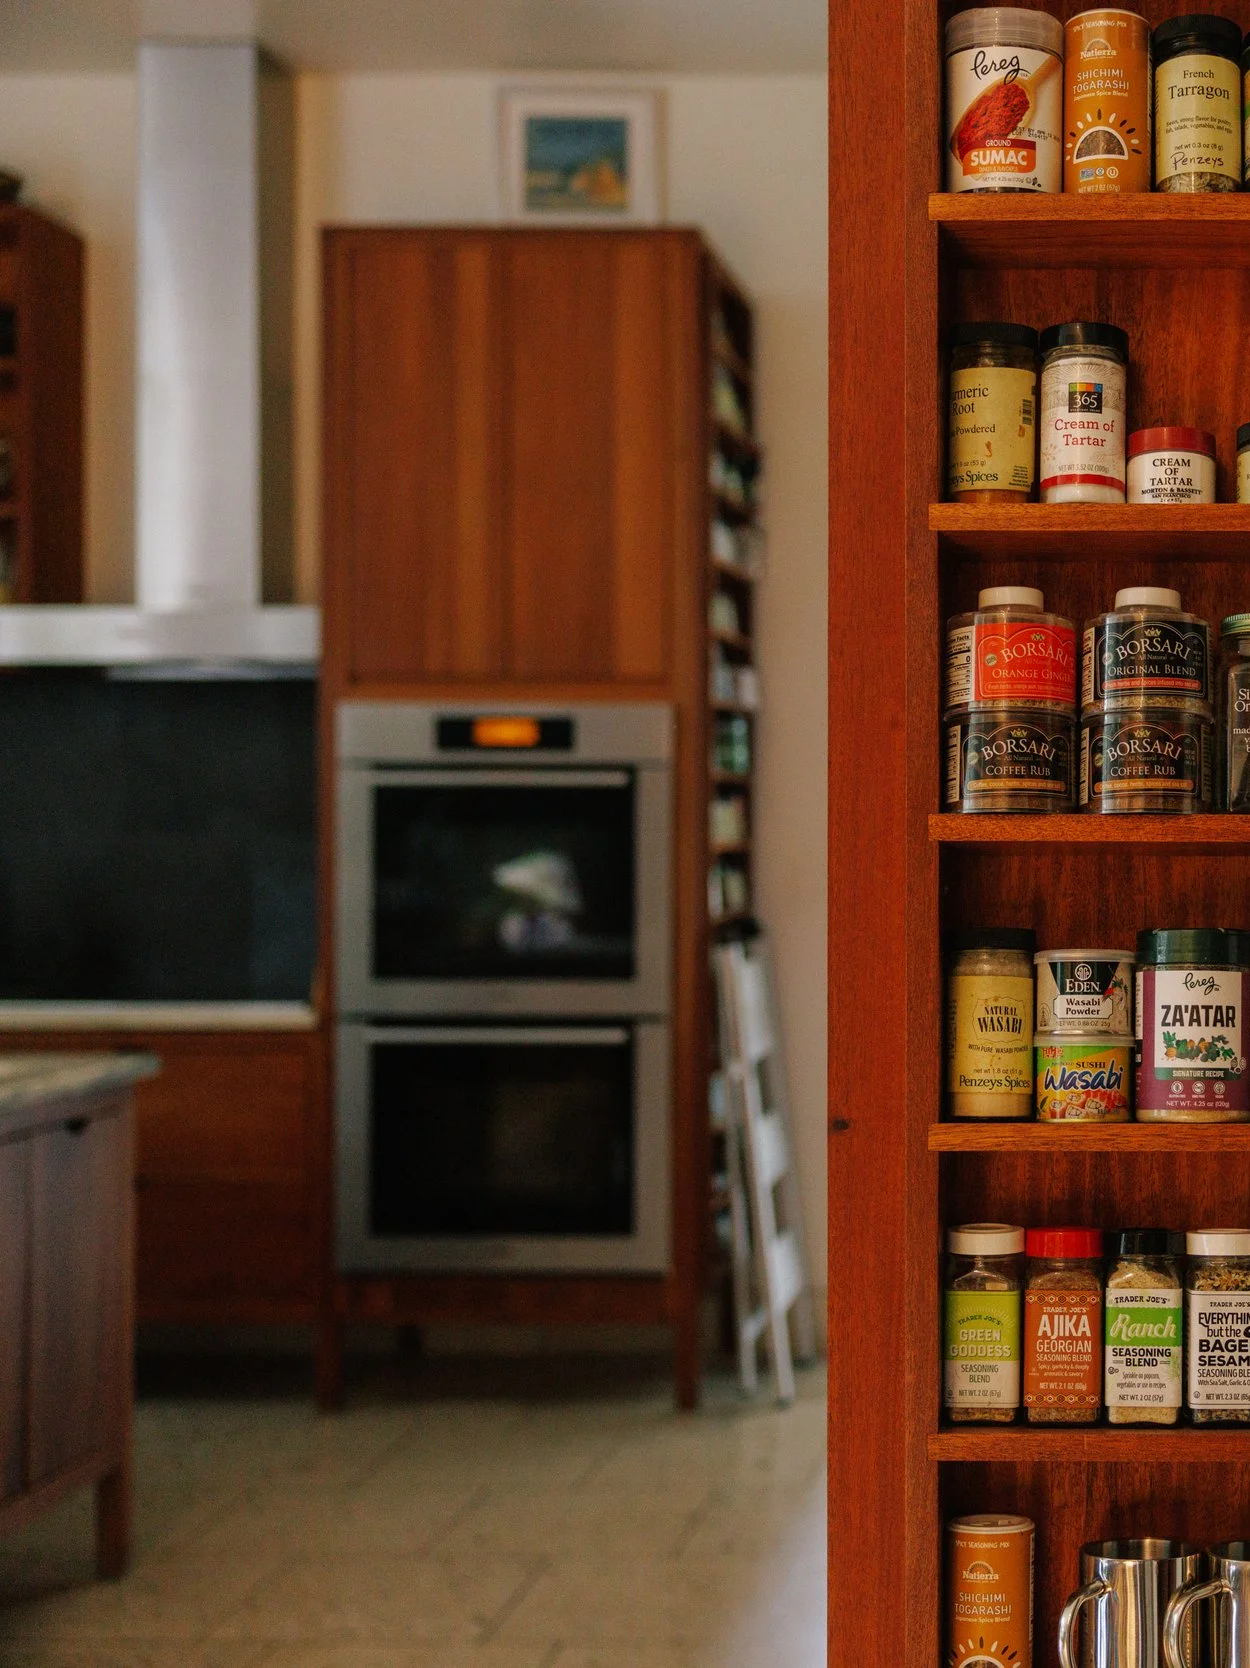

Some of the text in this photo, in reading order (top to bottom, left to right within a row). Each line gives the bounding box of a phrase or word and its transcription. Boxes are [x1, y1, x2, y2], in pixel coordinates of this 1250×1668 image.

[1080, 50, 1117, 59] Natierra
[970, 50, 1026, 85] Pereg
[1077, 69, 1123, 81] SHICHIMI
[1183, 70, 1214, 79] French
[1073, 81, 1129, 94] TOGARASHI
[1168, 85, 1230, 100] Tarragon
[971, 151, 1027, 166] SUMAC
[1171, 152, 1224, 170] Penzeys
[1073, 394, 1098, 408] 365
[952, 403, 975, 417] Root
[955, 424, 995, 435] Powdered
[1054, 419, 1115, 432] Cream of
[1063, 434, 1106, 448] Tartar
[1152, 458, 1191, 467] CREAM
[965, 471, 999, 483] Spices
[1165, 468, 1179, 476] OF
[1150, 477, 1193, 486] TARTAR
[1001, 641, 1068, 667] BORSARI
[1116, 637, 1190, 661] BORSARI
[1107, 665, 1196, 676] ORIGINAL BLEND
[981, 739, 1056, 761] BORSARI
[1107, 739, 1182, 761] BORSARI
[985, 765, 1051, 776] COFFEE RUB
[1110, 765, 1176, 777] COFFEE RUB
[1065, 978, 1100, 992] EDEN
[1182, 972, 1218, 995] Pereg
[1066, 998, 1101, 1006] Wasabi
[984, 1006, 1018, 1016] NATURAL
[1066, 1007, 1101, 1015] Powder
[1161, 1005, 1235, 1027] ZA'ATAR
[978, 1017, 1023, 1034] WASABI
[1045, 1060, 1124, 1090] Wasabi
[960, 1075, 1030, 1091] Penzeys Spices
[1147, 1296, 1168, 1304] JOE'S
[1038, 1315, 1091, 1339] AJIKA
[1110, 1313, 1177, 1341] Ranch
[1207, 1326, 1241, 1337] but the
[960, 1329, 1001, 1341] GREEN
[951, 1345, 1011, 1357] GODDESS
[1036, 1340, 1092, 1352] GEORGIAN
[1036, 1354, 1092, 1362] SEASONING BLEND
[1112, 1348, 1171, 1357] SEASONING
[961, 1364, 999, 1373] SEASONING
[1125, 1358, 1158, 1367] BLEND
[969, 1374, 990, 1383] BLEND
[1198, 1369, 1237, 1377] SEASONING
[963, 1571, 999, 1580] Natierra
[959, 1593, 1006, 1603] SHICHIMI
[955, 1604, 1011, 1615] TOGARASHI
